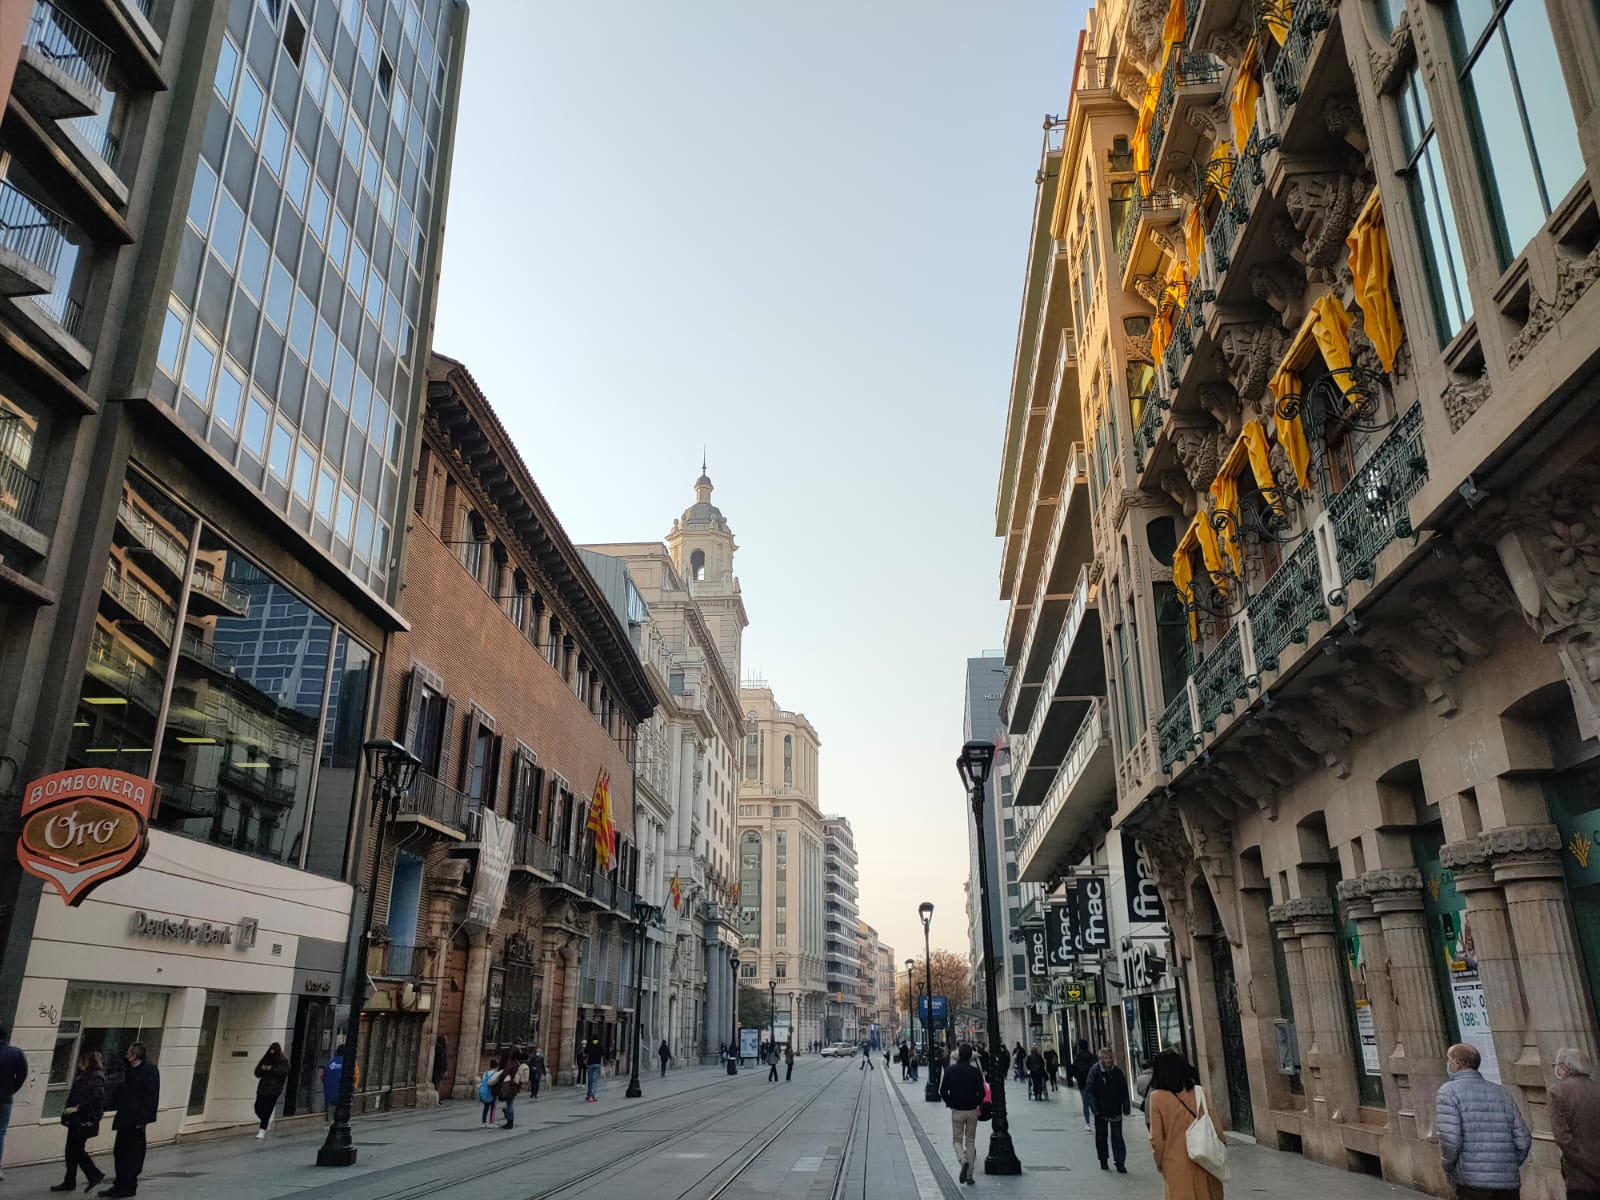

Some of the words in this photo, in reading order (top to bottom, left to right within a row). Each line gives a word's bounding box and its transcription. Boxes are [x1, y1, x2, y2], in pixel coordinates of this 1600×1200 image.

[29, 774, 146, 805] BOMBONERA
[44, 811, 120, 849] Oro
[132, 910, 200, 943] Deutsche
[199, 921, 232, 945] Bank
[1058, 907, 1075, 960] fnac
[1085, 882, 1105, 945] fnac
[1031, 932, 1046, 975] fnac
